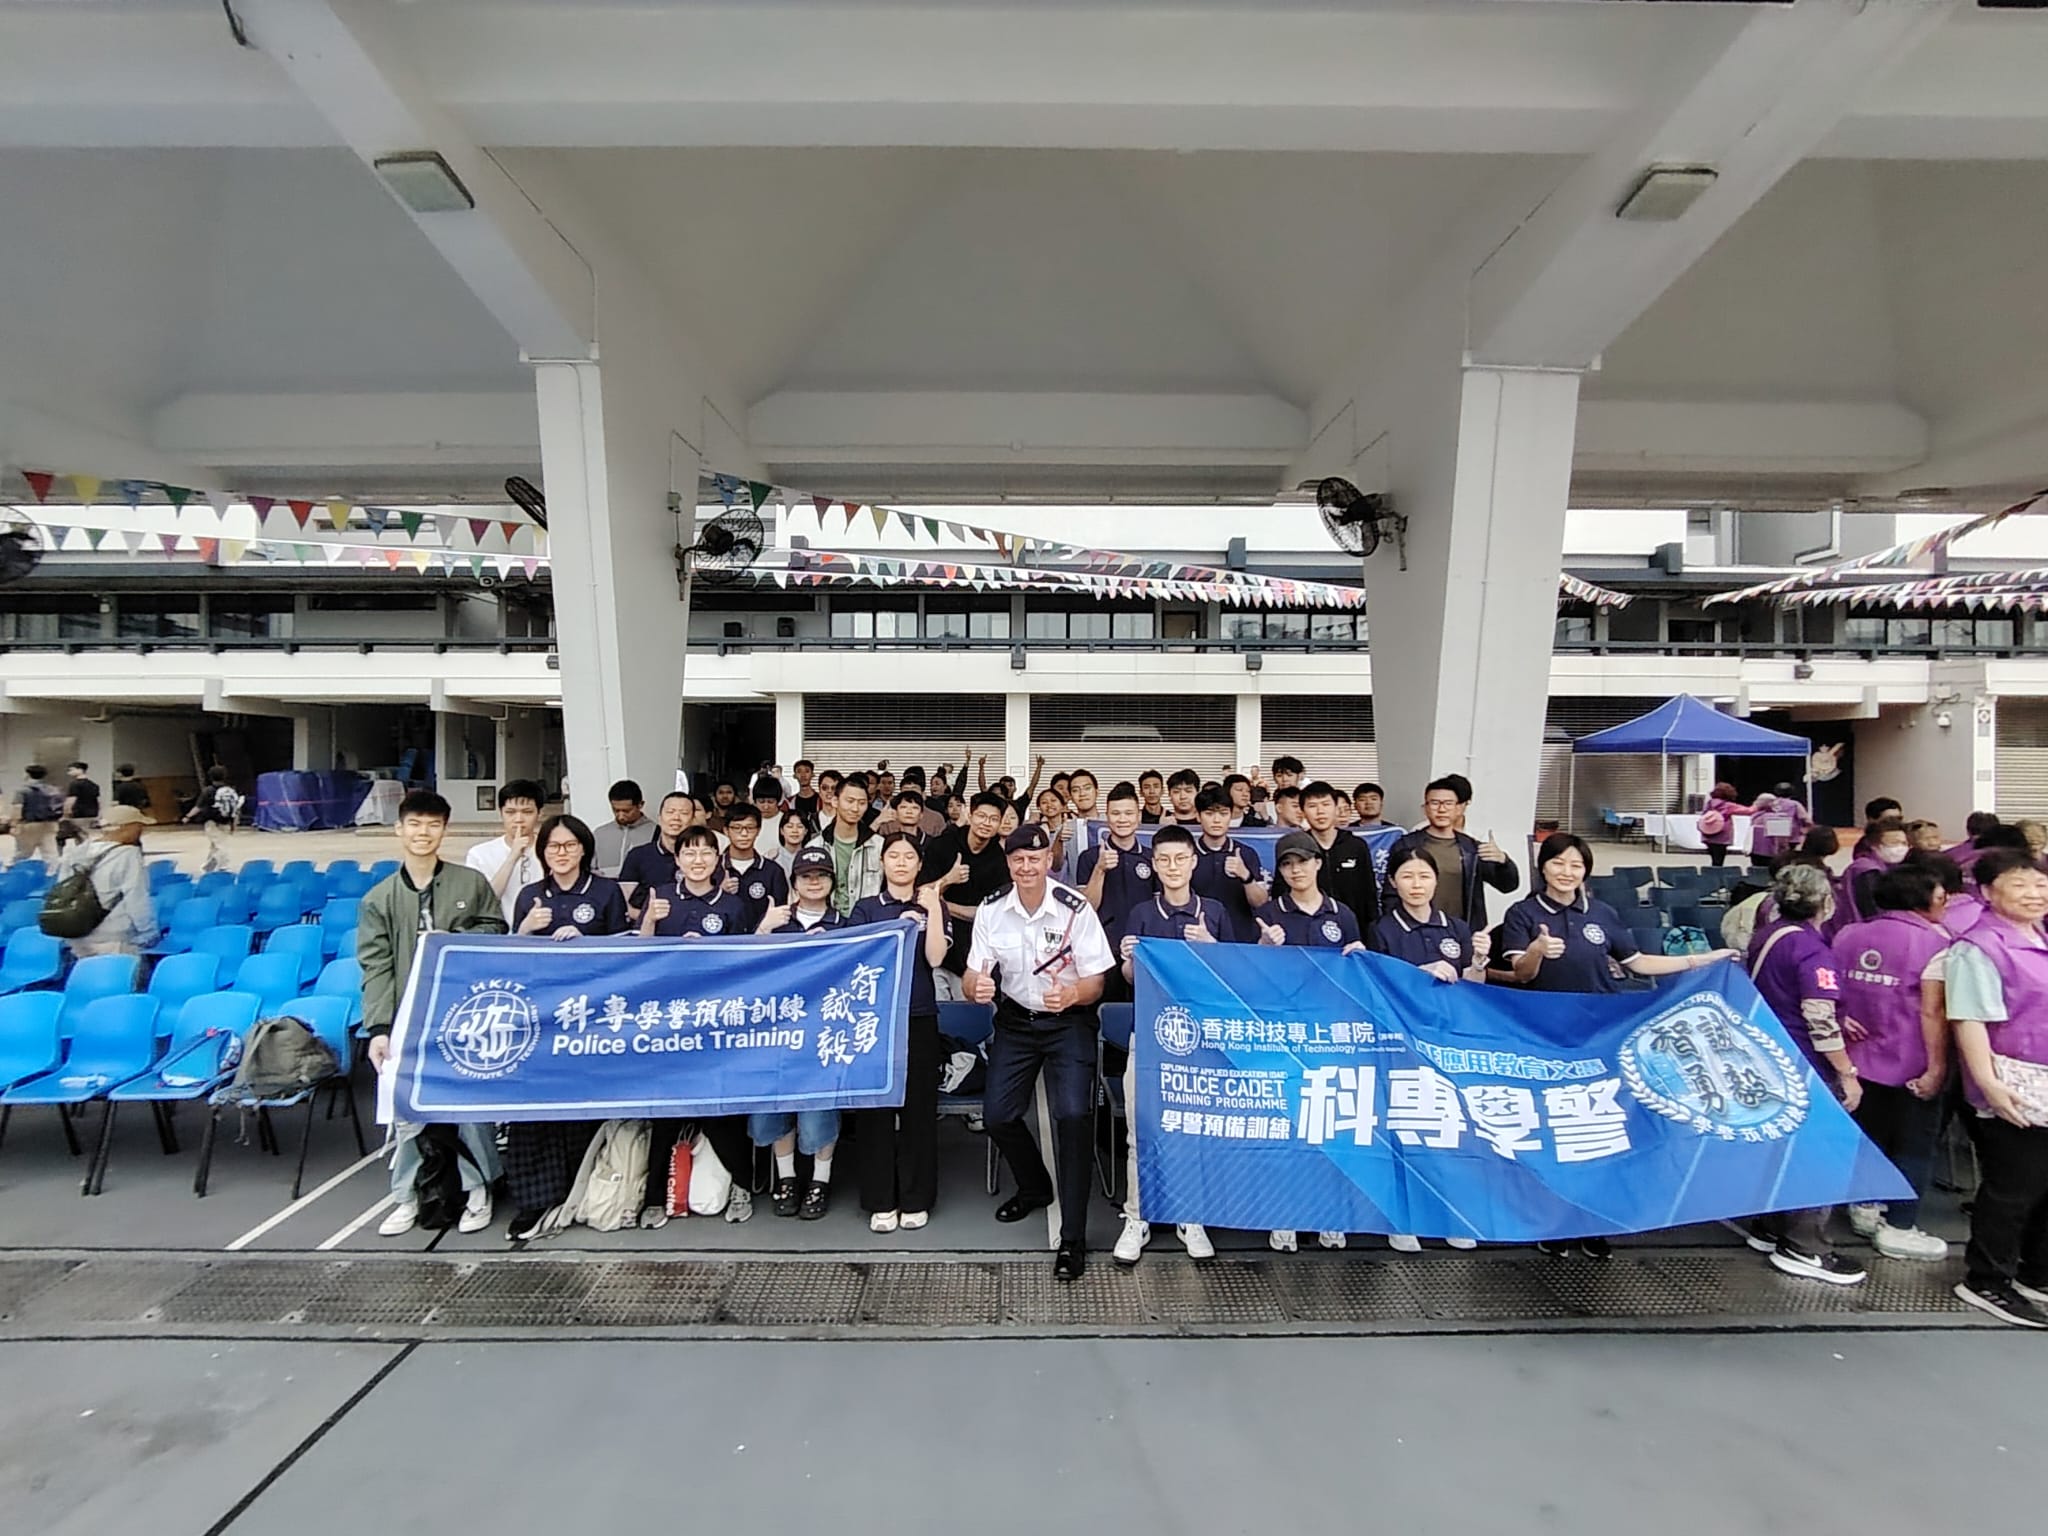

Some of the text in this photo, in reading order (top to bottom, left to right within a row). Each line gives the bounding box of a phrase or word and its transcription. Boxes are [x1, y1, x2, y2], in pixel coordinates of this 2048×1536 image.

[470, 979, 526, 994] HKIT
[553, 994, 807, 1033] 科專學警預備訓練
[552, 1027, 805, 1055] Police Cadet Training
[1201, 1018, 1375, 1044] 香港科技專上書院
[1201, 1040, 1226, 1052] Hong
[1228, 1041, 1252, 1053] Kong
[1254, 1042, 1290, 1054] Institute
[1292, 1044, 1301, 1053] of
[1303, 1044, 1356, 1055] Technology
[451, 1062, 504, 1080] INSTITUTE
[1160, 1062, 1189, 1074] DIPLOMA
[1190, 1066, 1199, 1074] OF
[1200, 1067, 1229, 1079] APPLIED
[1229, 1069, 1269, 1079] EDUCATION
[1161, 1071, 1285, 1098] POLICE CADET
[1161, 1090, 1288, 1110] TRAINING PROGRAMME
[1161, 1109, 1291, 1139] 學警預備訓練
[1297, 1066, 1632, 1163] 科專學警
[665, 1177, 676, 1216] Coffee
